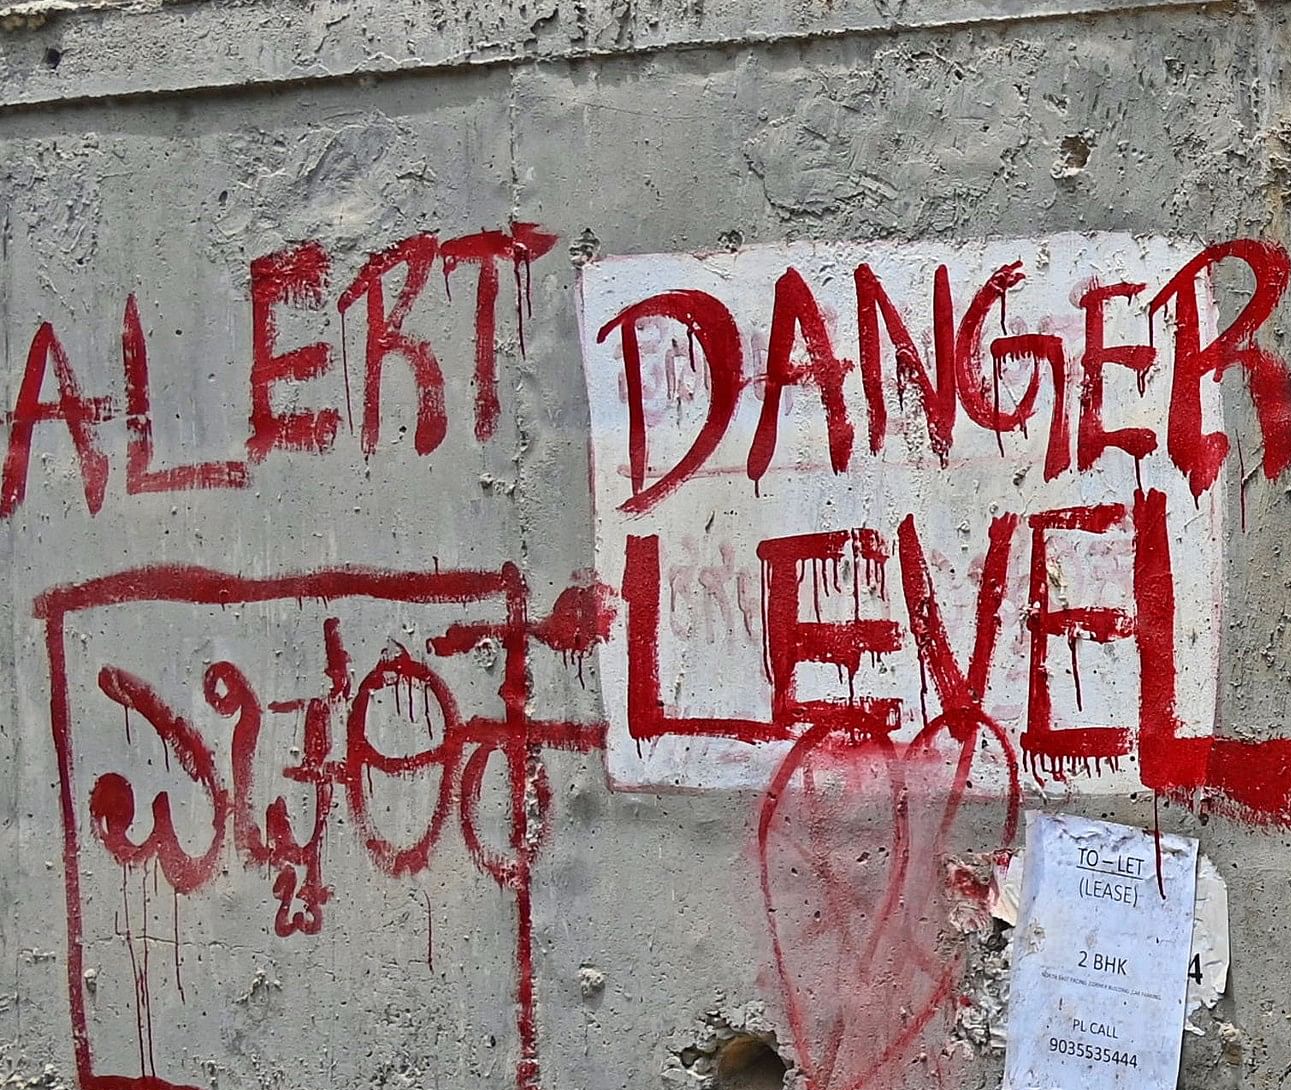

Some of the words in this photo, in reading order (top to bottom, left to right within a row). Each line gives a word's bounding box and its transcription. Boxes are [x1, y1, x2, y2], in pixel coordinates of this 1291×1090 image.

[0, 222, 560, 518] ALERT
[1078, 847, 1098, 868] TO
[1117, 855, 1145, 876] LET
[1079, 877, 1138, 907] (LEASE)
[1077, 950, 1088, 968] 2
[1093, 953, 1128, 976] BHK
[1072, 1018, 1086, 1033] PL
[1089, 1022, 1119, 1039] CALL
[1050, 1037, 1138, 1069] 9035535444
